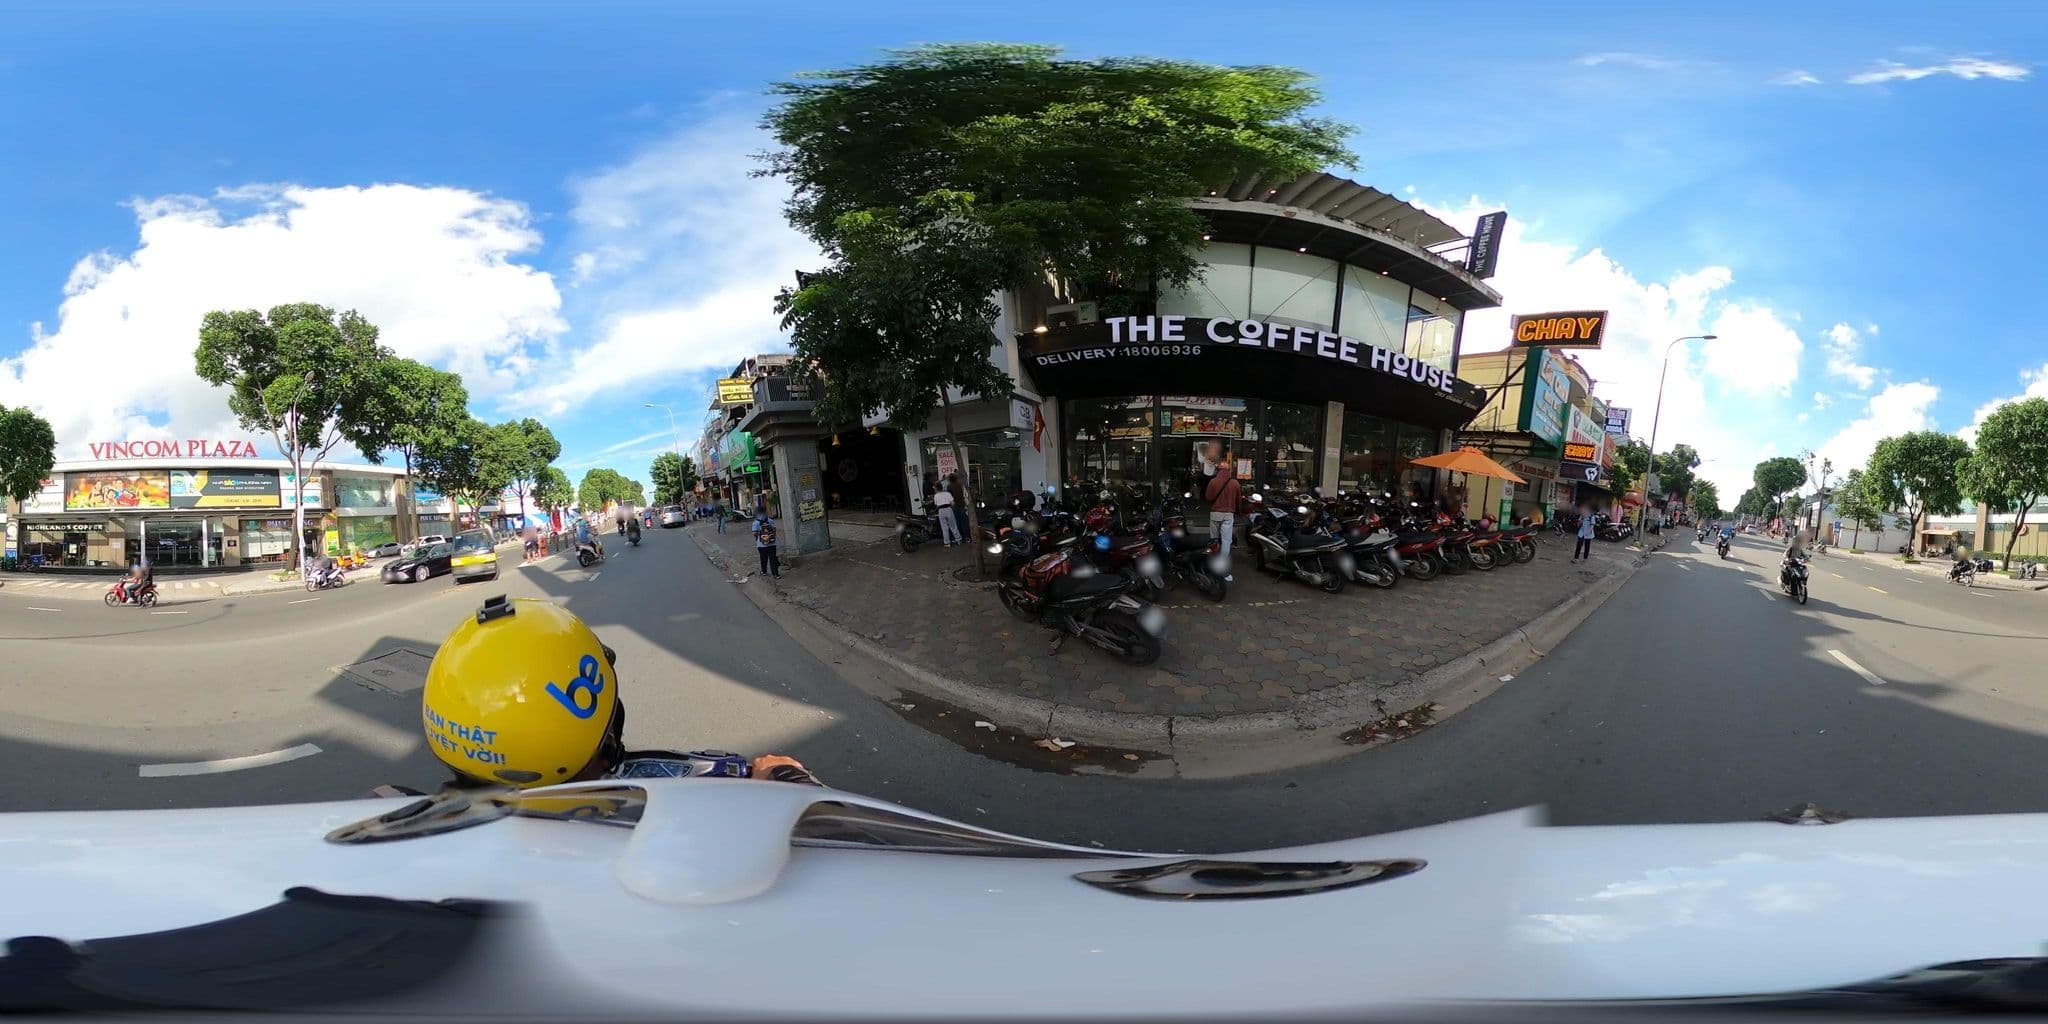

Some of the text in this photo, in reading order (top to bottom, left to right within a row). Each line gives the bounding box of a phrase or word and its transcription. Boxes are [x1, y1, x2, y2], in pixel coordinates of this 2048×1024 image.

[1518, 317, 1600, 341] CHAY
[1105, 315, 1455, 393] THE COFFEE HOUSE
[89, 439, 258, 459] VINCOM PLAZA
[545, 654, 604, 719] be
[448, 720, 497, 747] THẬT
